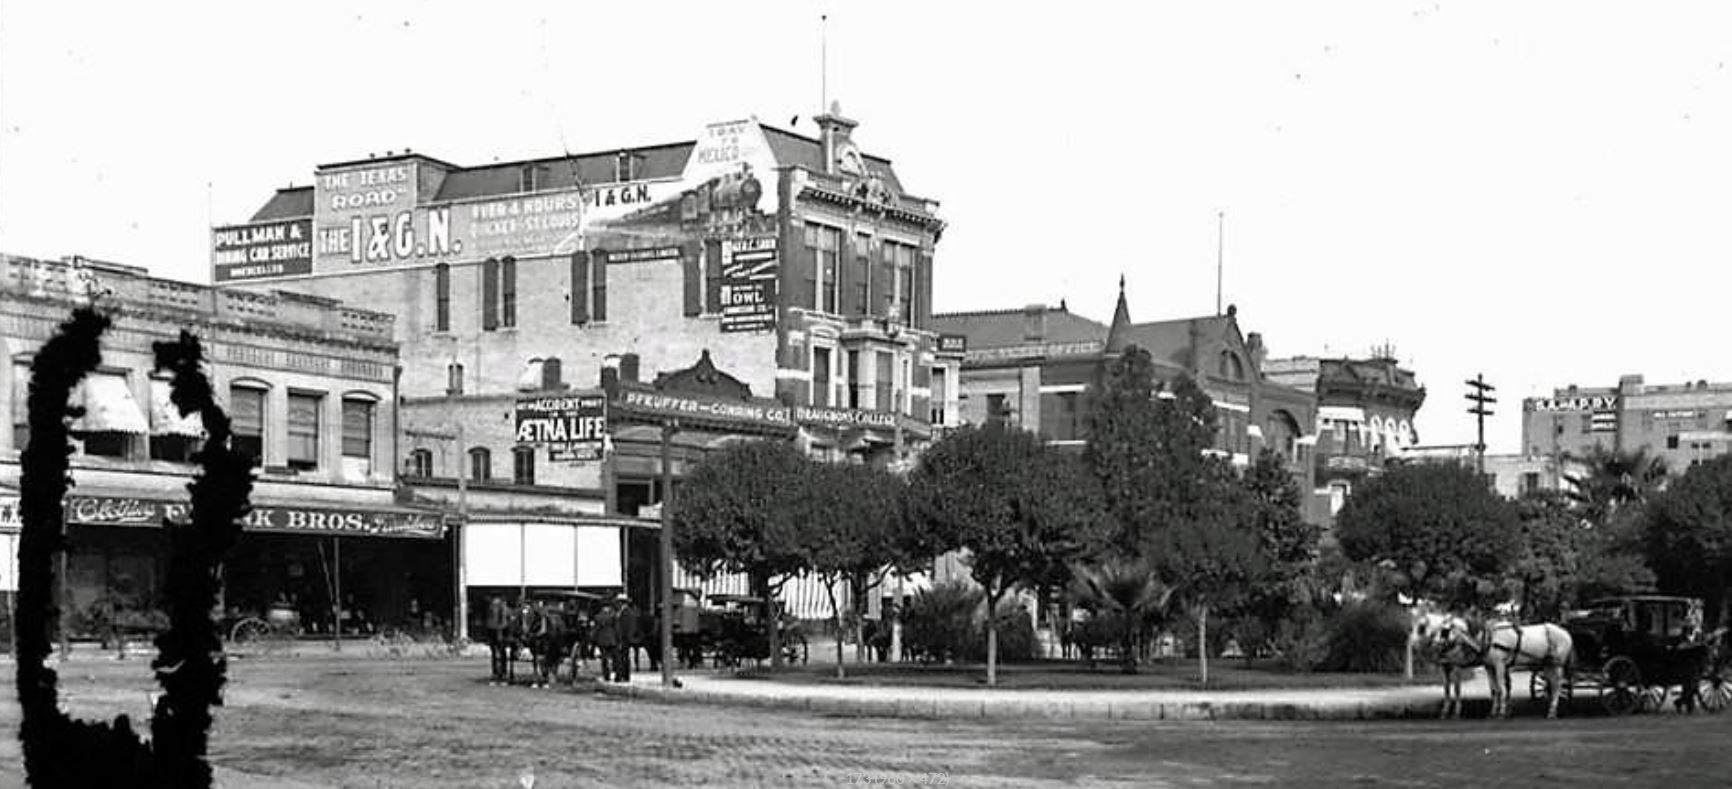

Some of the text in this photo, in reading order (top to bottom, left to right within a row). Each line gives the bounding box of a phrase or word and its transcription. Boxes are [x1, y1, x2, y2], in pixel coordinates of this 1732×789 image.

[216, 225, 285, 246] PULLMAN
[319, 227, 351, 255] THE
[365, 213, 391, 263] &
[395, 208, 462, 260] G.N.
[732, 291, 764, 305] OWL
[569, 416, 604, 440] LIFE
[286, 510, 370, 531] BROS.
